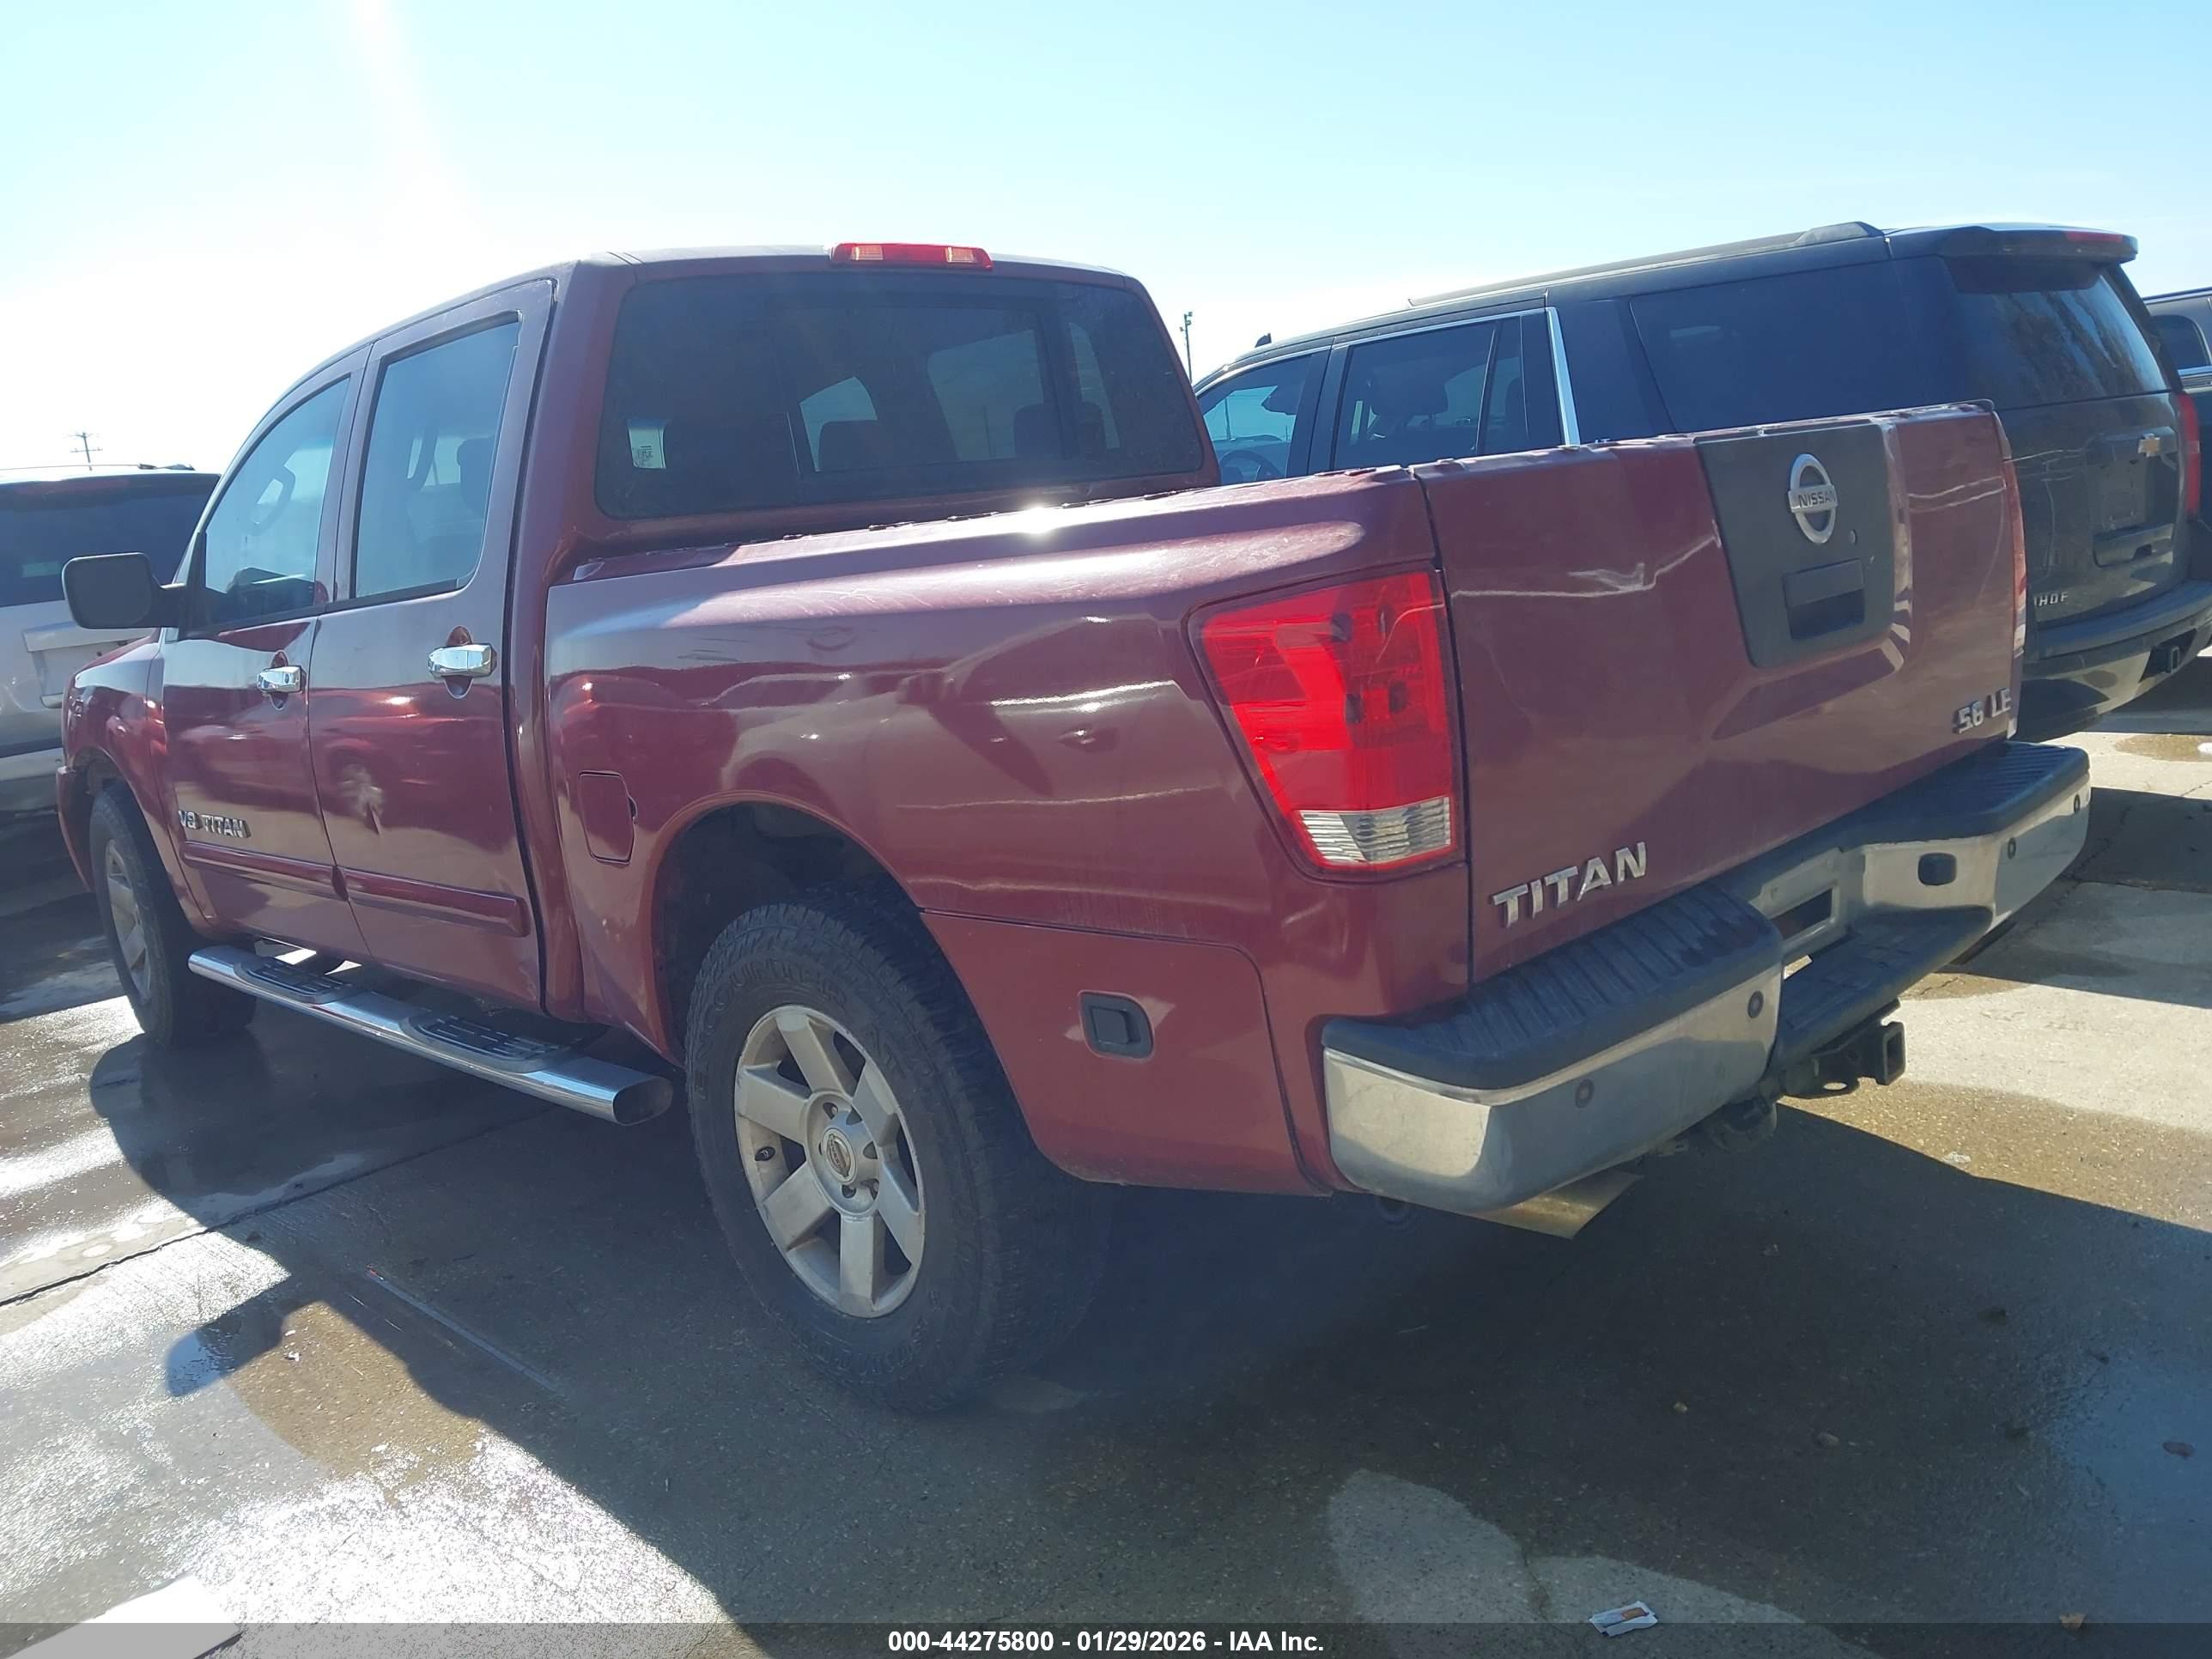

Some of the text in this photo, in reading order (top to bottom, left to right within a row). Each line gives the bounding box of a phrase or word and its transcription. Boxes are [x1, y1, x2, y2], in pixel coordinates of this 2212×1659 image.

[1798, 489, 1836, 508] NISSAN
[1990, 687, 2012, 718] LE
[179, 810, 246, 838] V8 TITAN
[1492, 841, 1648, 927] TITAN
